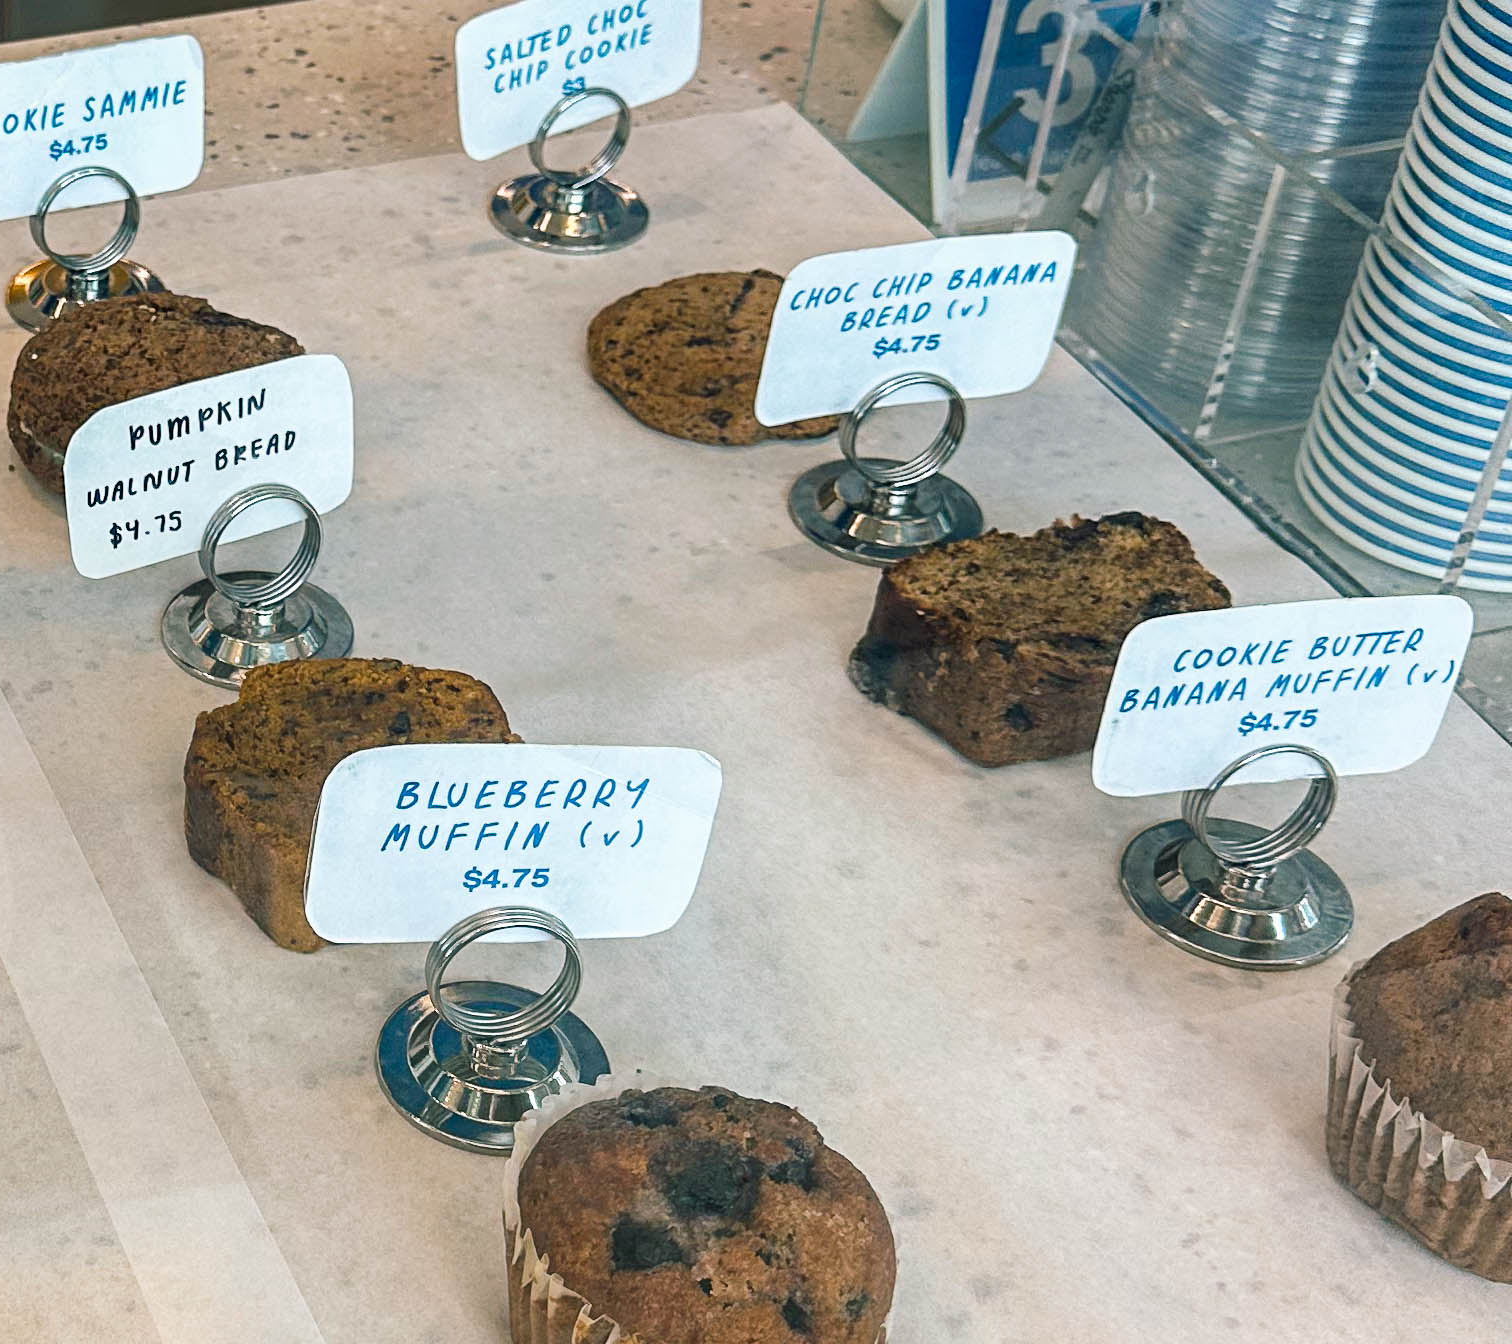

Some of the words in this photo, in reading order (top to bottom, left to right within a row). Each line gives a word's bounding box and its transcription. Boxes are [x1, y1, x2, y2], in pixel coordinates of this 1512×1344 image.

[484, 24, 571, 70] SALTED
[494, 60, 548, 94] CHIP
[564, 24, 653, 70] COOKIE
[82, 79, 187, 122] SAMMIE
[49, 133, 108, 161] $4.75
[790, 282, 860, 311] CHOC
[872, 272, 933, 299] CHIP
[947, 261, 1058, 291] BANANA
[840, 302, 932, 332] BREAD
[872, 333, 941, 359] $4.75
[128, 388, 267, 450] PUMPKIN
[87, 460, 195, 508] WALNUT
[215, 430, 296, 471] BREAD
[109, 510, 183, 548] $4.75
[1173, 639, 1293, 672] COOKIE
[1309, 628, 1425, 660] BUTTER
[1120, 677, 1248, 713] BANANA
[1266, 665, 1390, 697] MUFFIN
[1238, 708, 1318, 736] $4.75
[396, 778, 650, 810] BLUEBERRY
[381, 821, 550, 852] MUFFIN
[462, 867, 550, 892] $4.75
